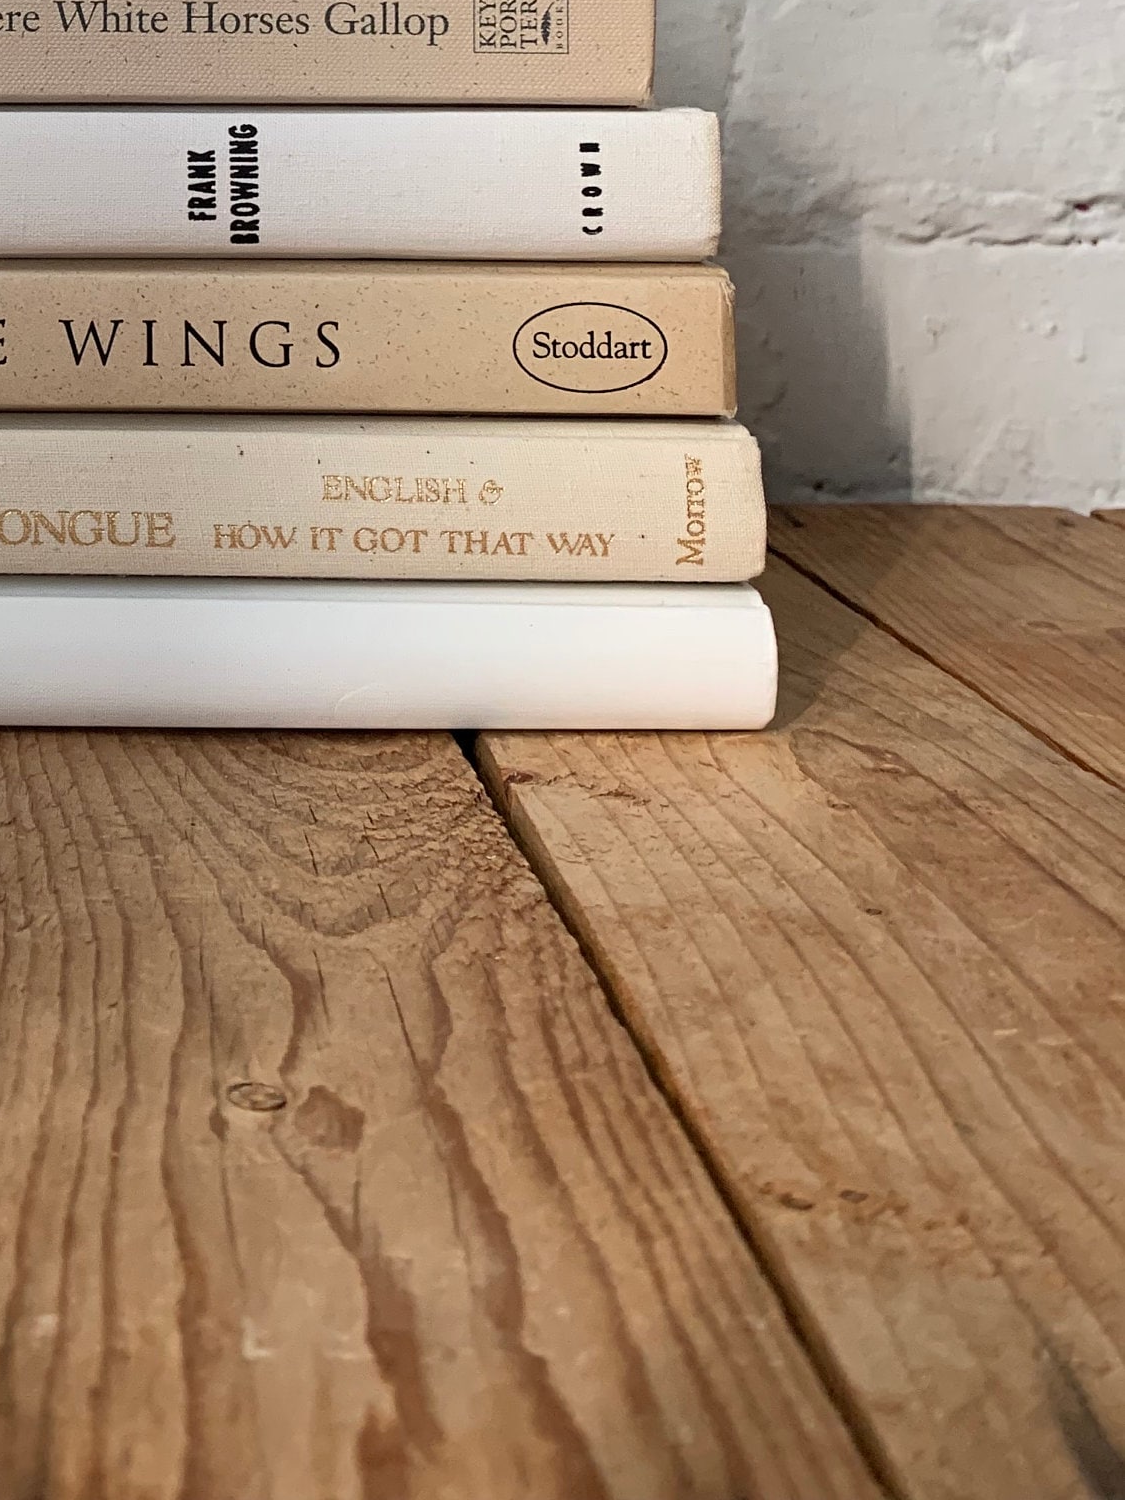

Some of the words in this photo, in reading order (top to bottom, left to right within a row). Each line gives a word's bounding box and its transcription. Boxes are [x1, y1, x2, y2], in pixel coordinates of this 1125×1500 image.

[53, 0, 170, 35] White
[181, 0, 311, 36] Horses
[324, 1, 451, 47] Gallop
[187, 148, 217, 221] FRANK
[229, 123, 260, 245] BROWNING
[579, 141, 603, 236] CROWN
[59, 318, 345, 370] WINGS
[532, 329, 653, 361] Stoddart
[321, 474, 467, 505] ENGLISH
[478, 478, 505, 505] &
[676, 454, 706, 567] Morrow
[213, 522, 297, 552] HOW
[310, 524, 344, 553] IT
[353, 526, 429, 555] GOT
[439, 529, 535, 556] THAT
[547, 532, 617, 558] WAY
